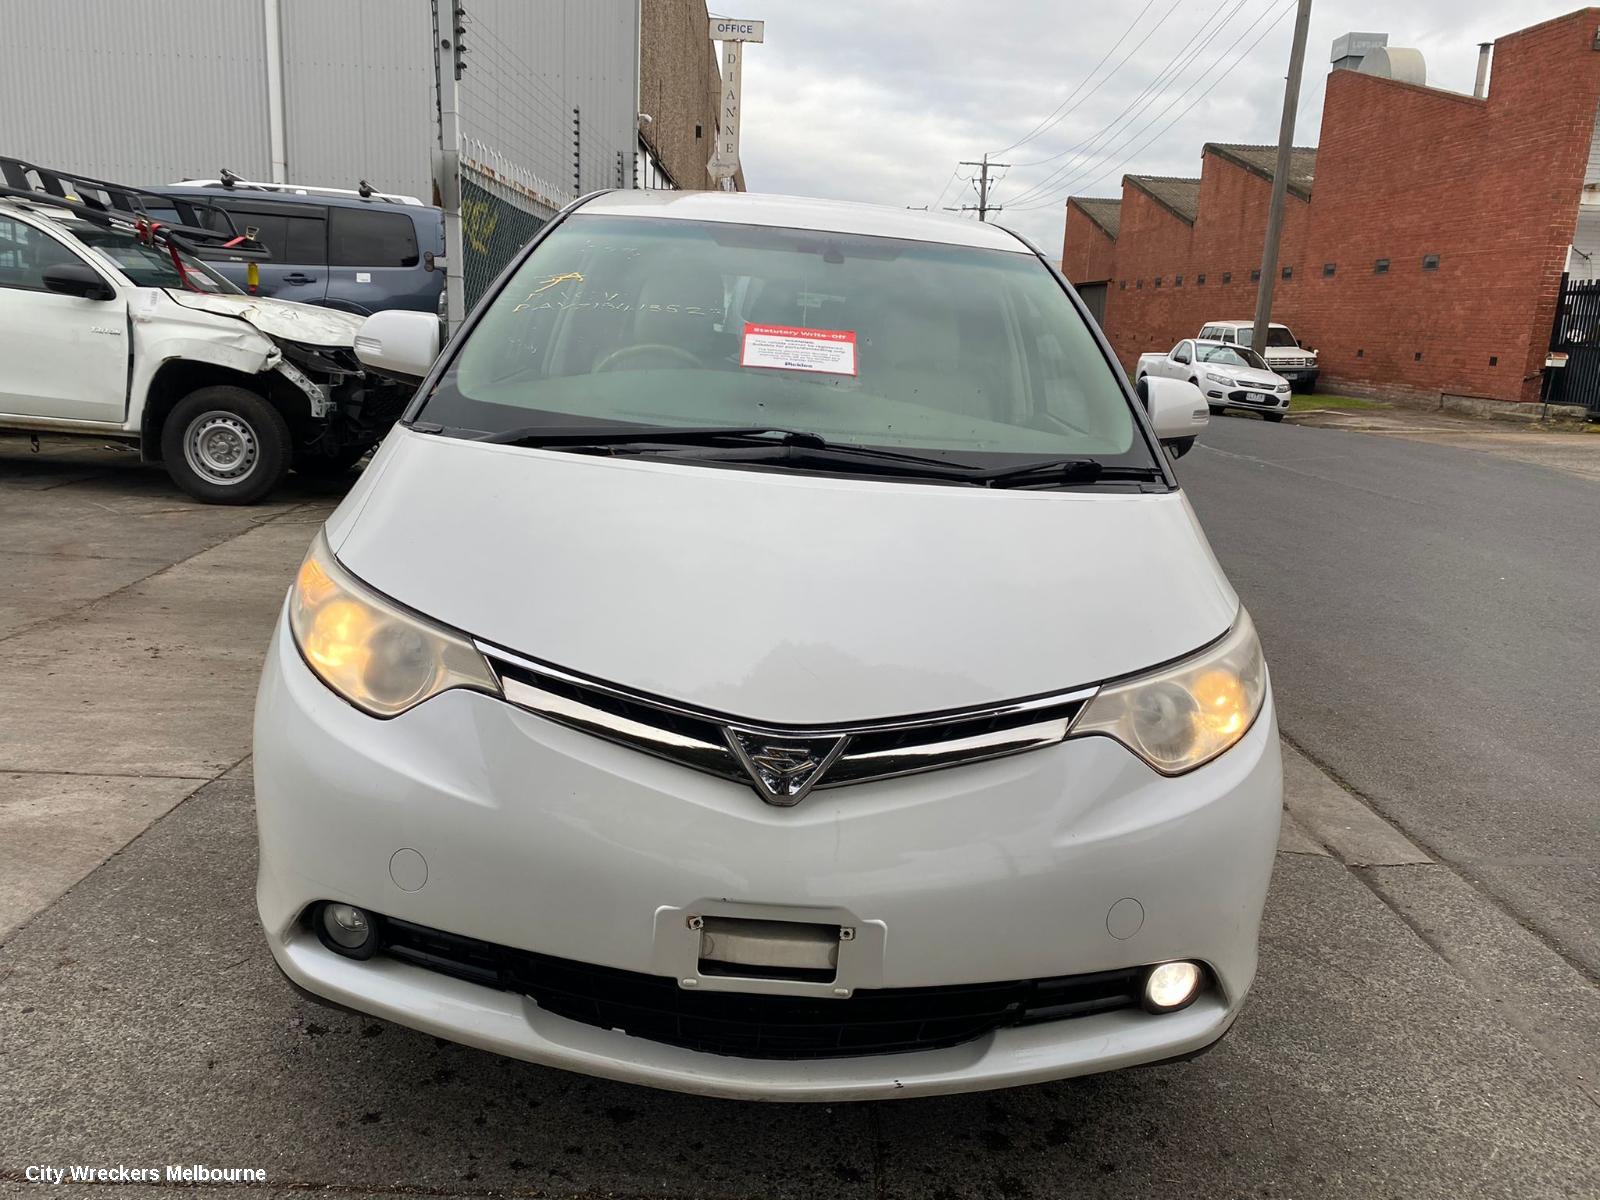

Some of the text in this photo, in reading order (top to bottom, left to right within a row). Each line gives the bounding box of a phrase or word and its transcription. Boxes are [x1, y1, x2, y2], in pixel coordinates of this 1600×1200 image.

[717, 23, 753, 34] OFFICE
[725, 53, 737, 154] DIANNE
[753, 327, 848, 340] Statutory Write-Off
